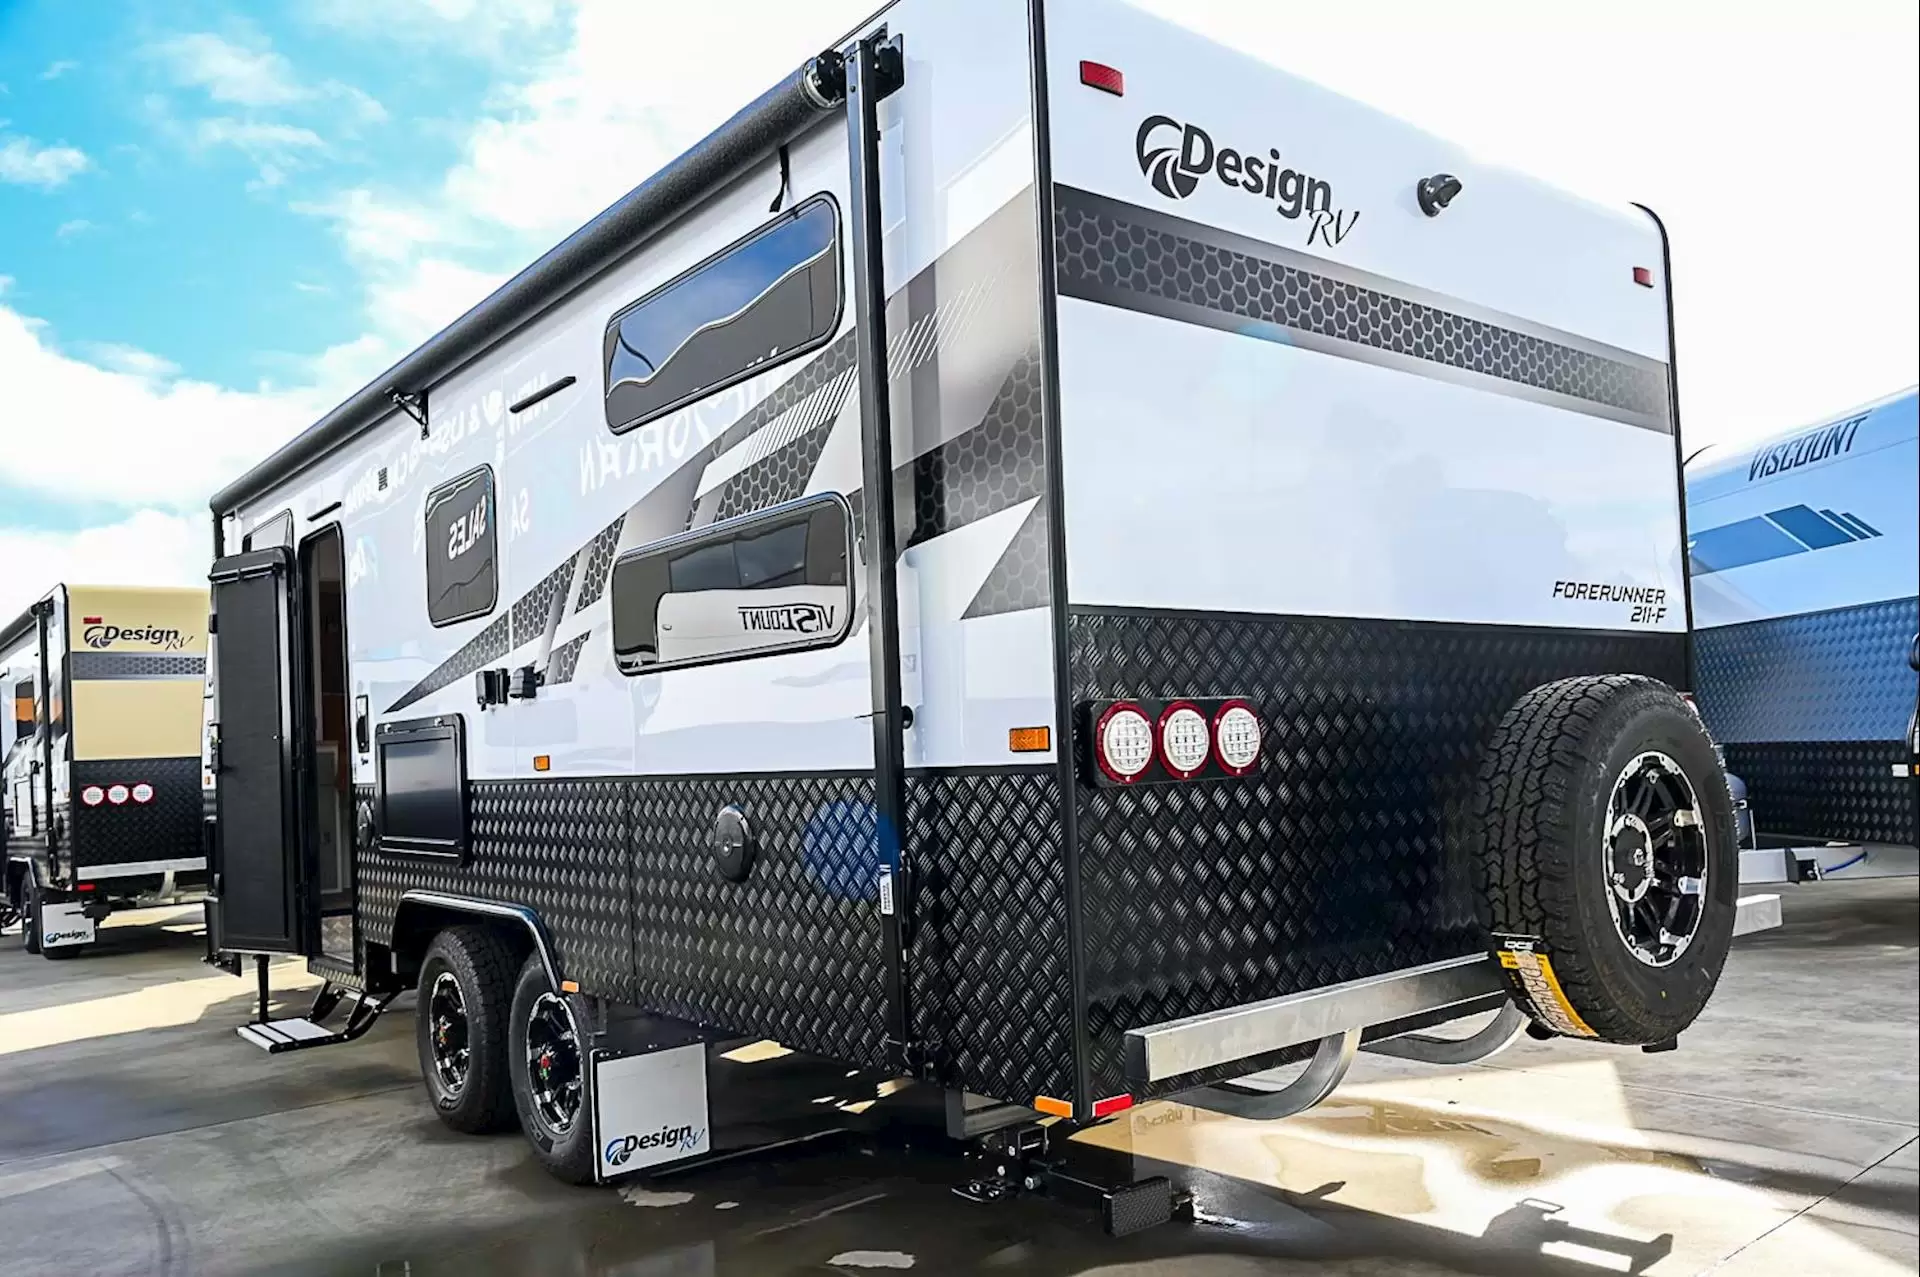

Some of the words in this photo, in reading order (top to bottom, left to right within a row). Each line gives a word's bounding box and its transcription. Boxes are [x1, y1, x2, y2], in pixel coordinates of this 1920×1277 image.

[1180, 123, 1332, 219] Design
[1307, 208, 1361, 248] RV
[1748, 416, 1868, 482] VISCOUNT
[1552, 581, 1666, 604] FORERUNNER
[1630, 606, 1667, 623] 211-F
[103, 625, 179, 645] Design
[165, 636, 194, 651] RV
[624, 1125, 692, 1153] Design
[679, 1128, 706, 1153] RV
